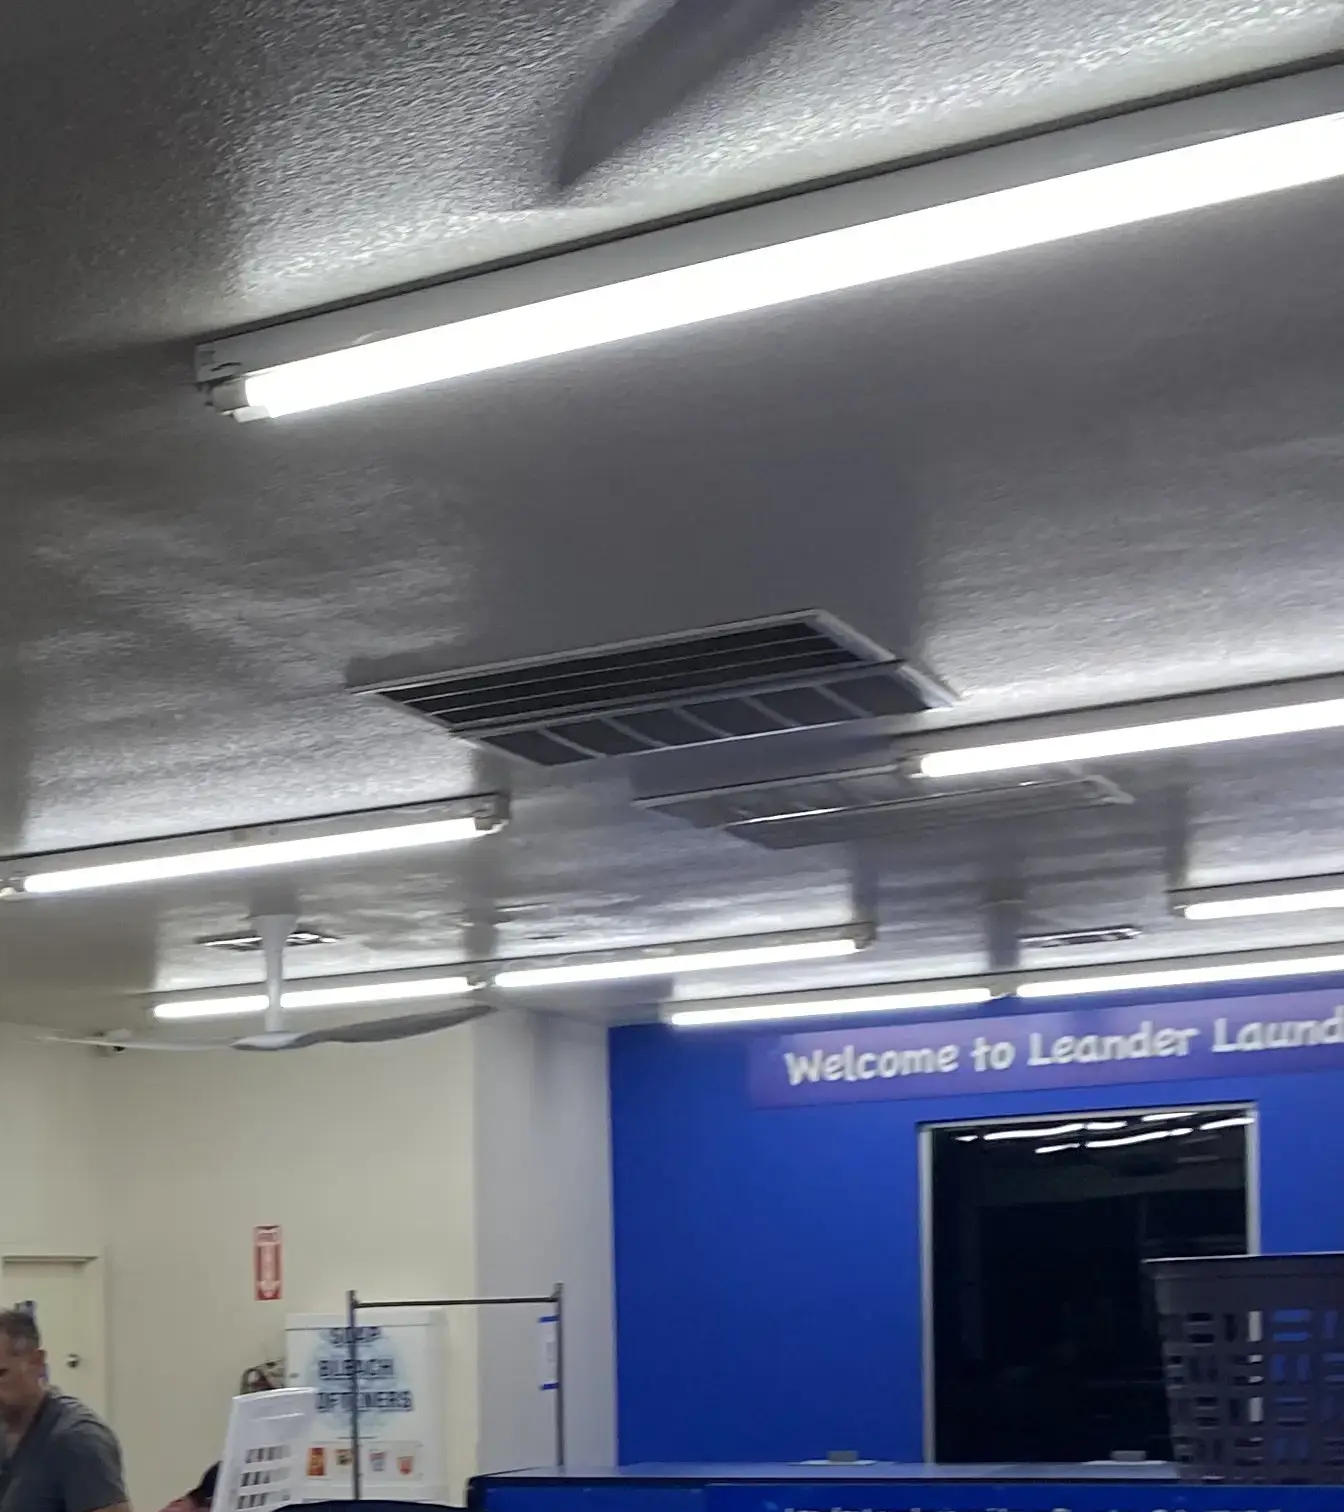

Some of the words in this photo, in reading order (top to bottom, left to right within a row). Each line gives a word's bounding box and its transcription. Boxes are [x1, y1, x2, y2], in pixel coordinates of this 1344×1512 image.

[784, 1038, 959, 1086] Welcome
[970, 1036, 1016, 1073] to
[1026, 1021, 1201, 1067] Leander
[318, 1358, 395, 1378] BLEACH
[315, 1391, 414, 1411] OFTENERS
